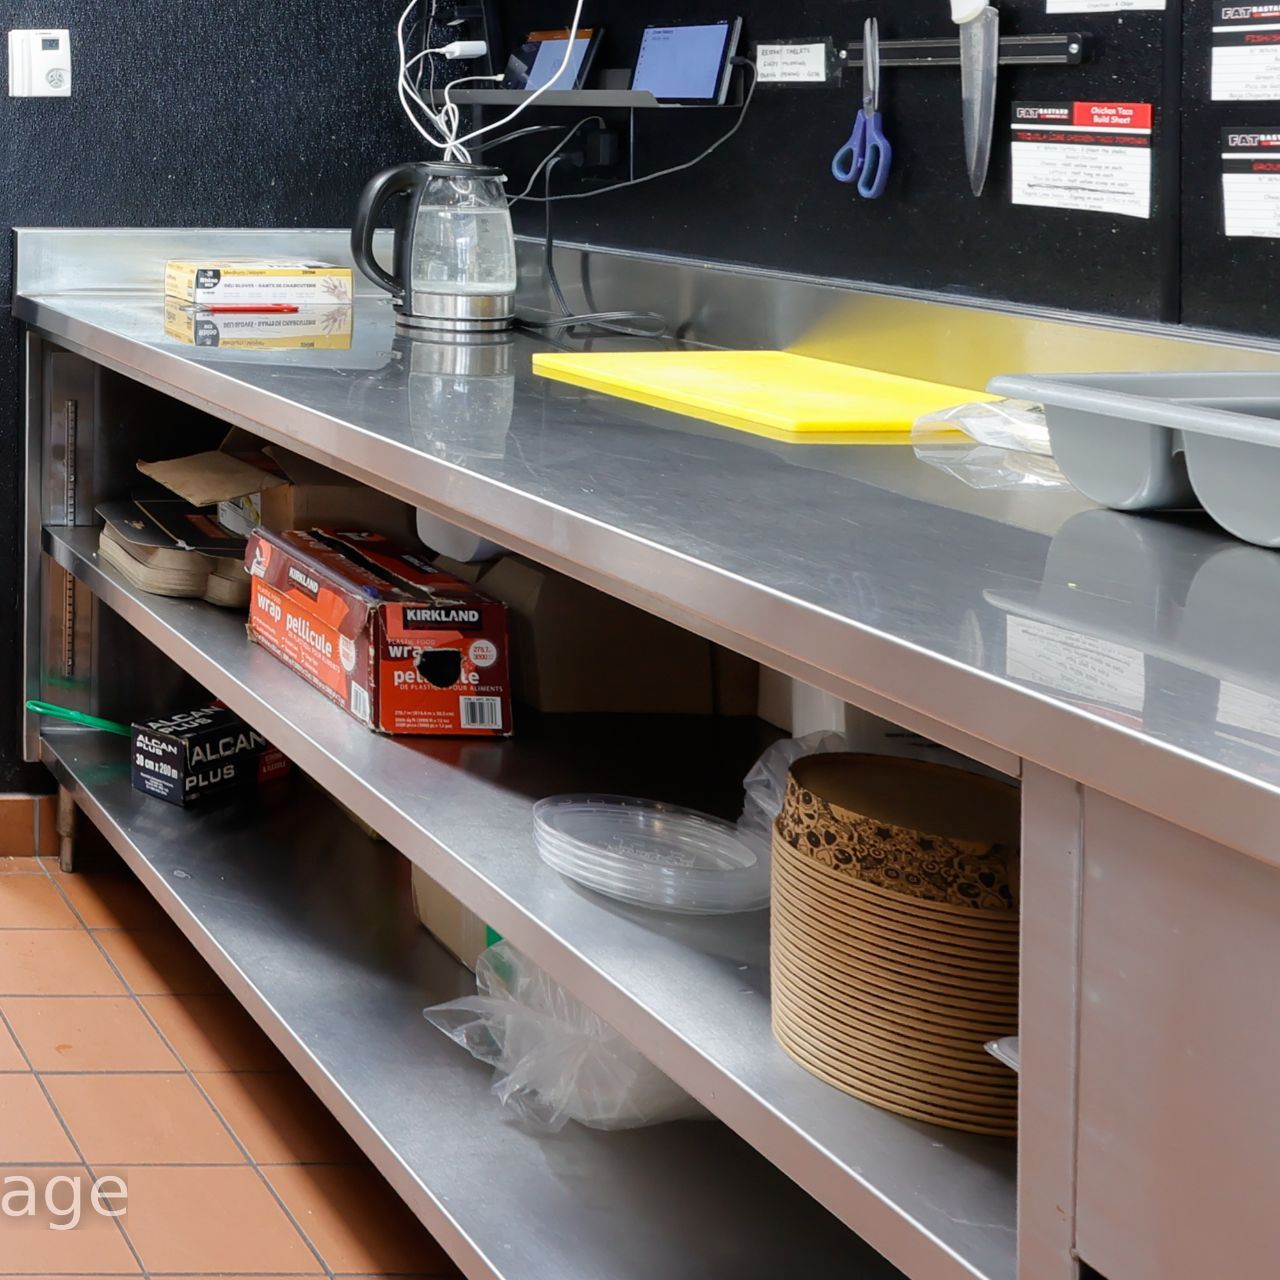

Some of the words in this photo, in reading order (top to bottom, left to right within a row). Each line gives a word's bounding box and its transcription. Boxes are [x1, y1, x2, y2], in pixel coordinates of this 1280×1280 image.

[1222, 6, 1251, 19] FAT
[1016, 107, 1039, 119] FAT
[1091, 106, 1116, 115] Chicken
[1093, 115, 1109, 123] Build
[1110, 116, 1131, 124] Sheet
[1228, 134, 1259, 146] FAT
[288, 566, 319, 594] KIRKLAND
[406, 608, 480, 622] KIRKLAND
[257, 593, 282, 622] wrap
[286, 611, 333, 658] pellicule
[388, 645, 433, 658] wra
[147, 706, 224, 729] ALCAN
[158, 717, 213, 734] PLUS
[136, 741, 163, 756] PLUS
[137, 734, 178, 755] ALCAN
[191, 730, 267, 766] ALCAN
[145, 758, 154, 770] cm
[159, 761, 171, 777] 200
[171, 768, 178, 779] m
[185, 764, 235, 792] PLUS
